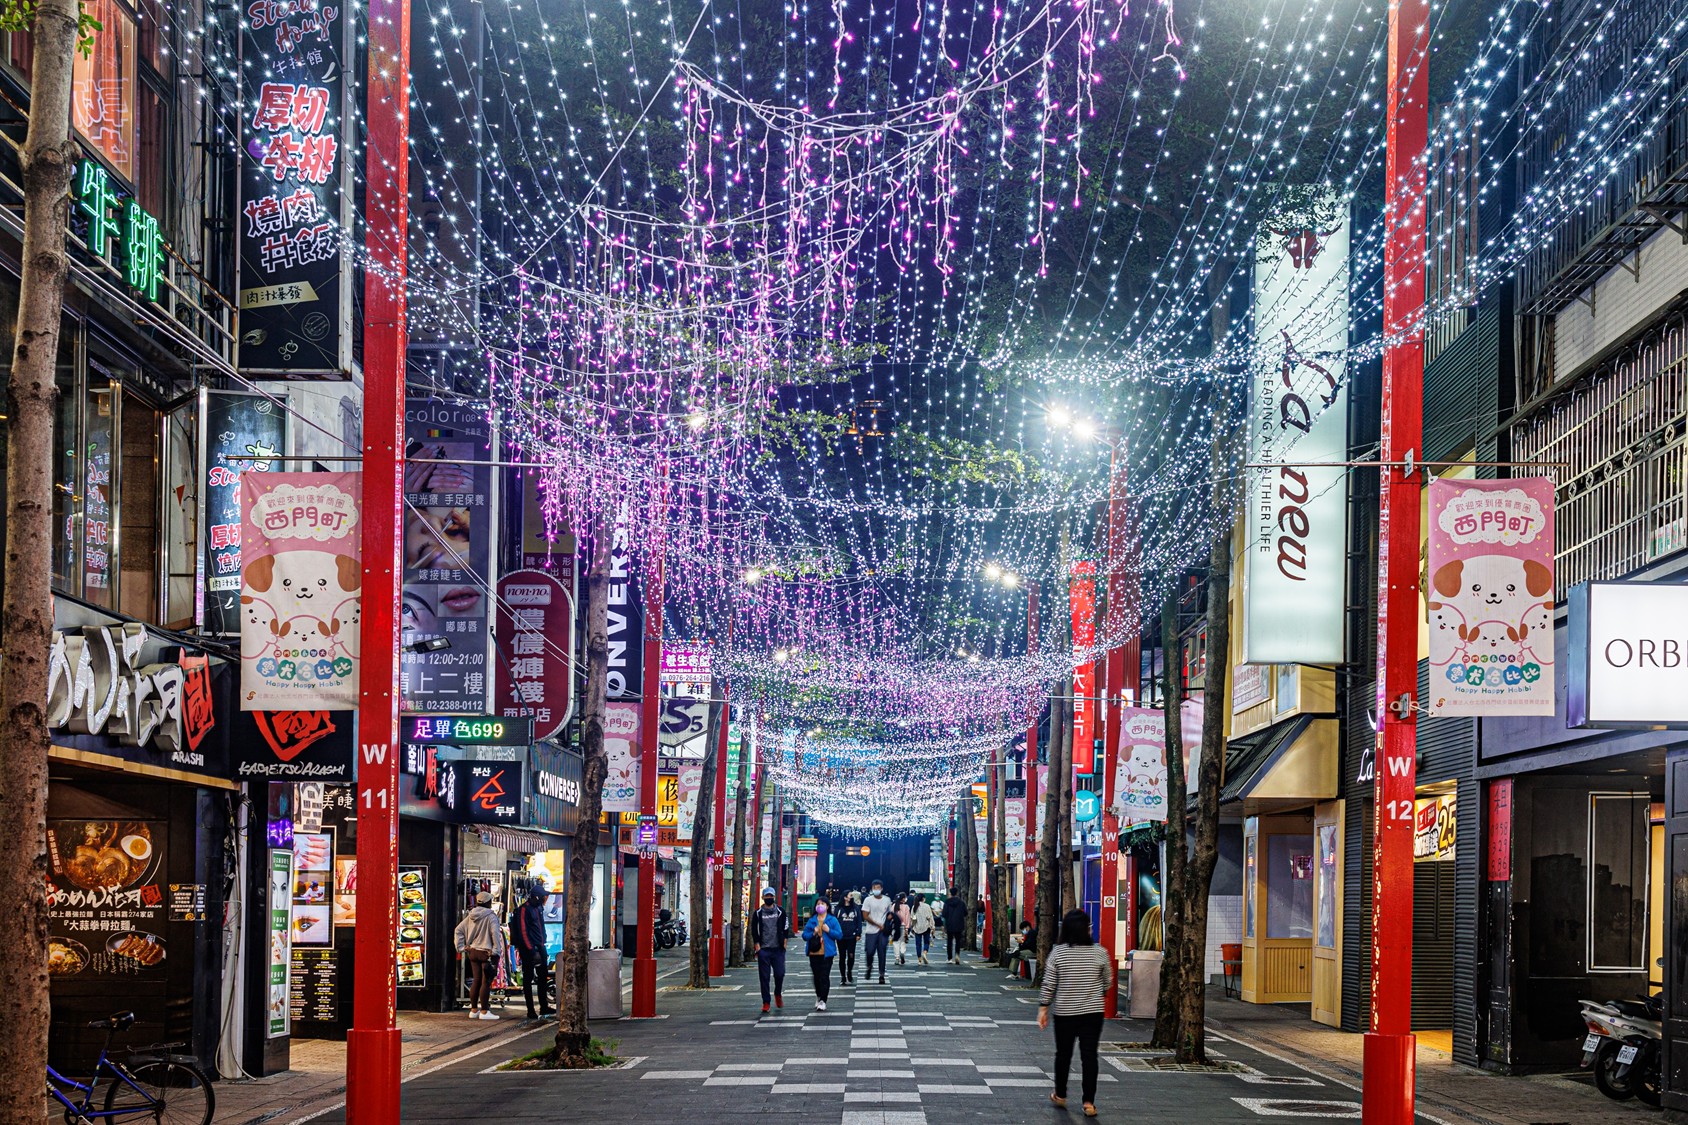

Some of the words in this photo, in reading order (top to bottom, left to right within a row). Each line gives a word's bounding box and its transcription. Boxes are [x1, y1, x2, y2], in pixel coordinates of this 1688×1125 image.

[253, 82, 330, 134] 厚切
[261, 134, 338, 183] 牛排
[243, 188, 320, 238] 燒肉
[79, 158, 164, 302] 牛排
[260, 223, 337, 273] 丼飯
[246, 285, 303, 304] 肉汁爆發
[403, 493, 439, 506] 甲光療
[444, 493, 485, 506] 手足保養
[1455, 498, 1532, 513] 歡迎來到優質商圈
[264, 506, 348, 531] 西門町
[1453, 510, 1535, 536] 西門町
[1260, 529, 1271, 553] LIFE
[418, 569, 462, 581] 嫁接睫毛
[429, 653, 484, 665] 12:00~21:00
[510, 608, 546, 703] 儂儂褲襪
[1604, 638, 1688, 668] ORB
[1455, 686, 1478, 694] Happy
[1482, 687, 1505, 695] Happy
[426, 700, 483, 711] 02-2388-0112
[414, 719, 504, 738] 足單色699
[171, 751, 205, 767] ARASHI
[362, 743, 388, 765] W
[472, 767, 491, 777] 부산
[1387, 756, 1412, 777] W
[539, 770, 575, 804] CONVERSE
[362, 788, 388, 809] 11
[495, 806, 516, 817] 두부
[1386, 799, 1413, 821] 12
[1105, 831, 1117, 842] W
[1105, 852, 1117, 861] 10
